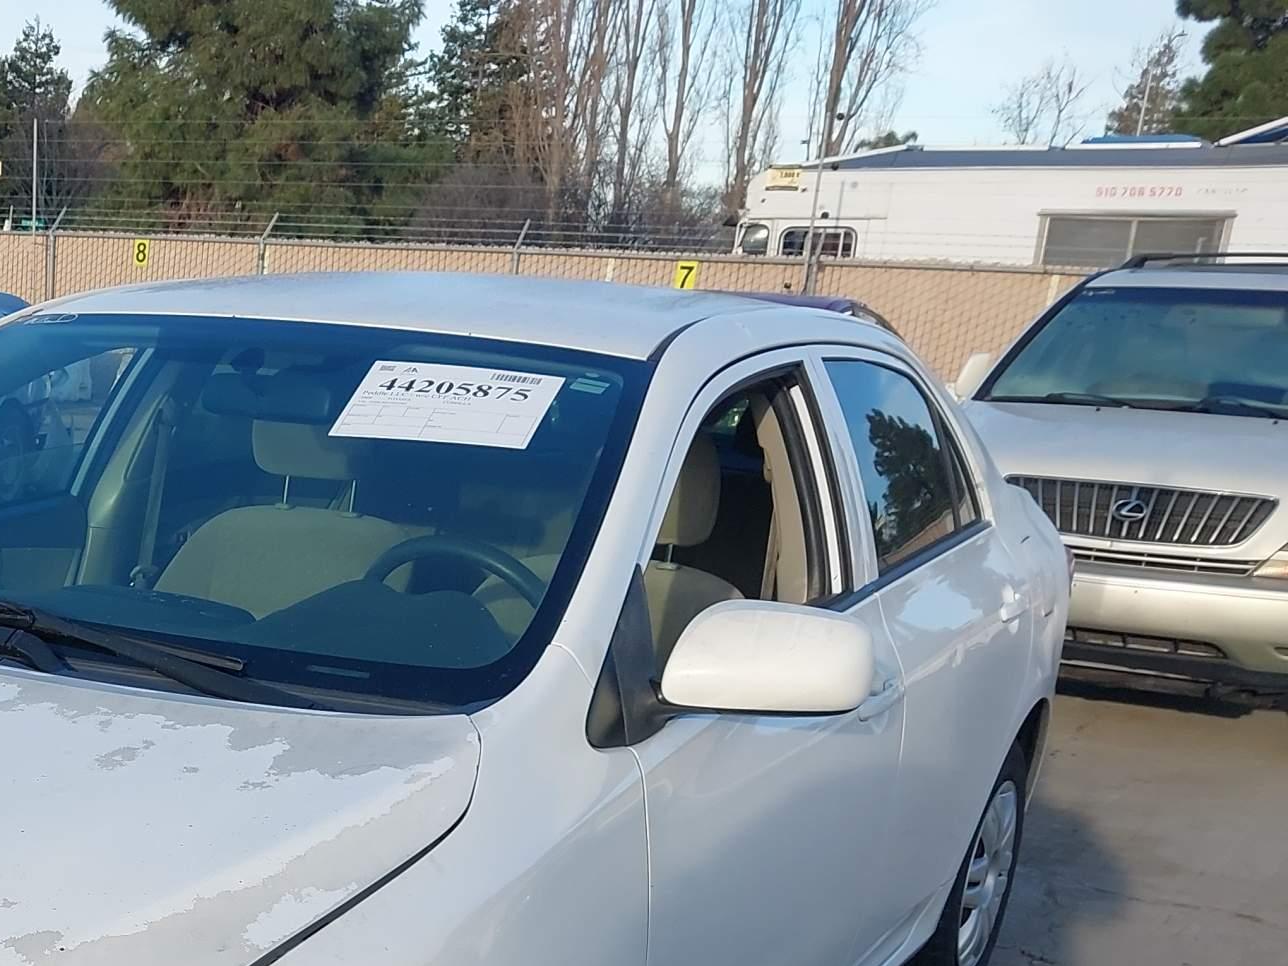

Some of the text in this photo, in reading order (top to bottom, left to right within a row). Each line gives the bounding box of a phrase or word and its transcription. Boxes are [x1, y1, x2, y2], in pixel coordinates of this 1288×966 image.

[136, 242, 147, 263] 8
[679, 265, 695, 288] 7
[378, 377, 532, 402] 44205875
